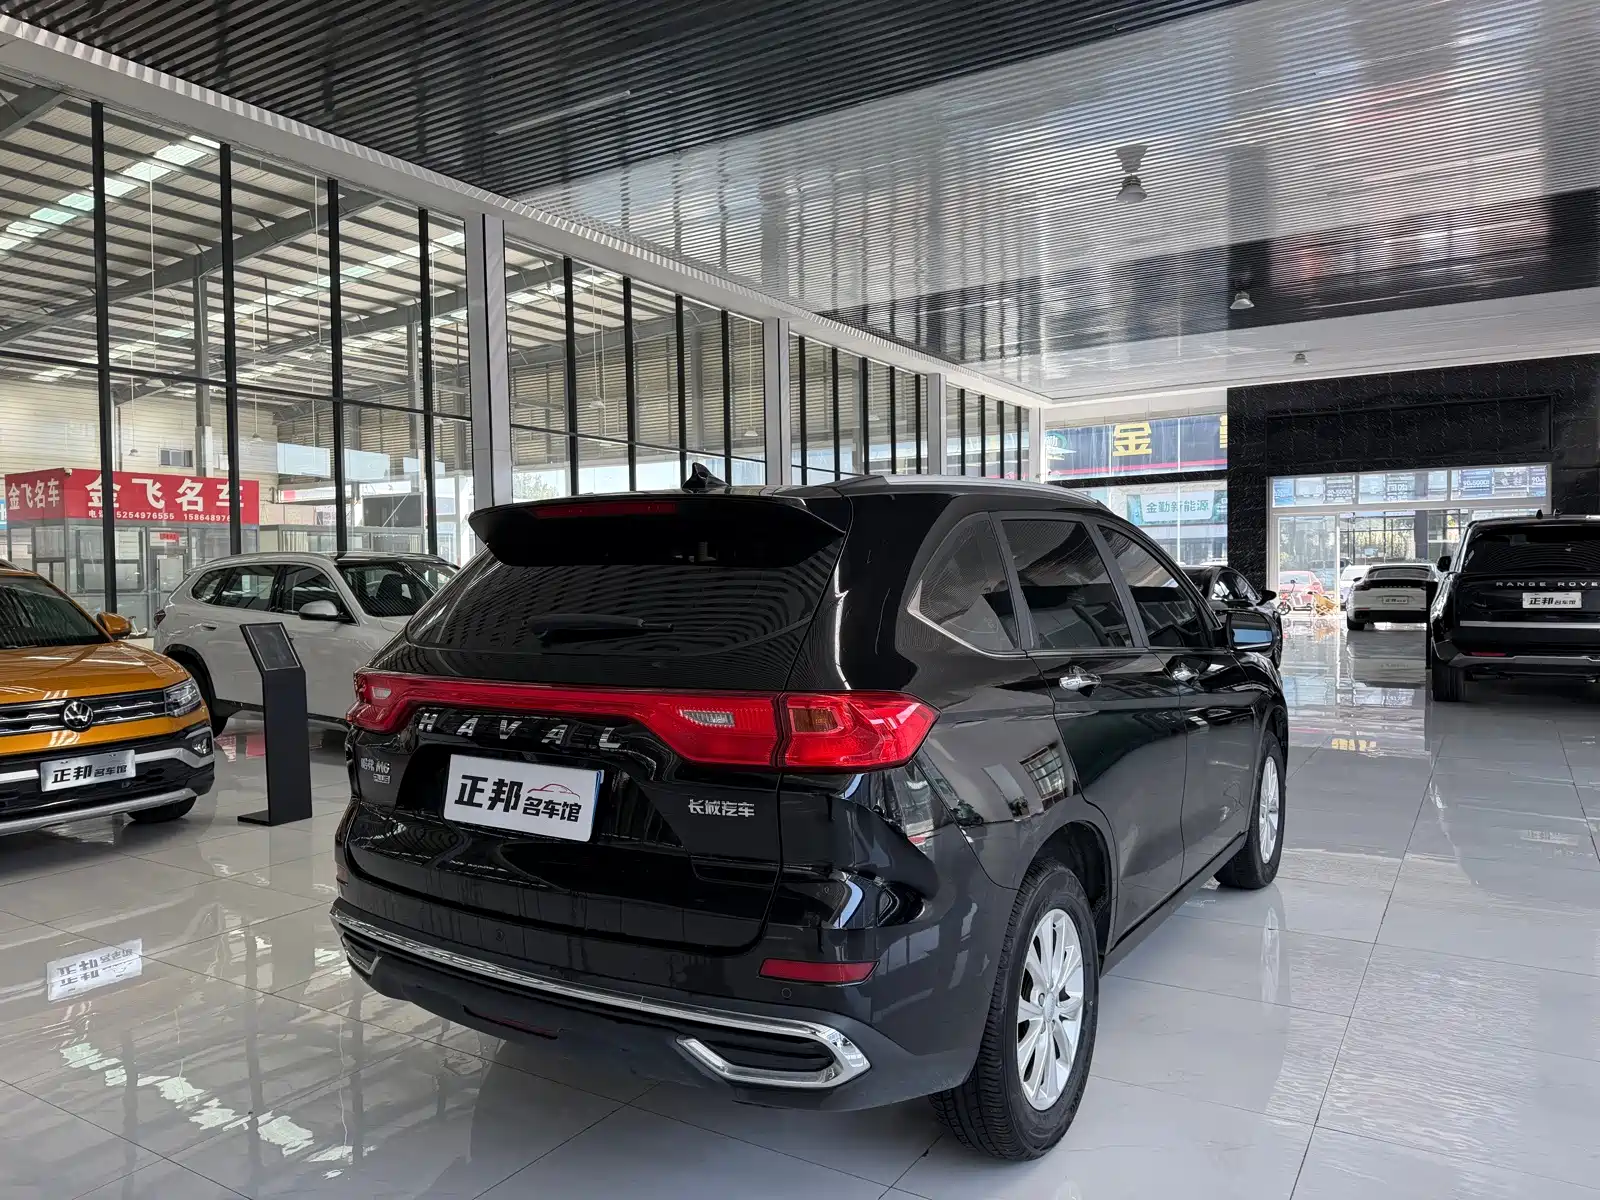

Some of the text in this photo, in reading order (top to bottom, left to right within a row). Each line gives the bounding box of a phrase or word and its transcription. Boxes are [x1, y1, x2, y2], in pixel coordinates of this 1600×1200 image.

[8, 478, 60, 511] 金飞名车
[85, 475, 244, 511] 金飞名车
[116, 511, 175, 520] 5254976555
[1146, 499, 1209, 514] 金勤新能源
[419, 712, 621, 749] HAVAL
[688, 798, 755, 817] 长城汽车
